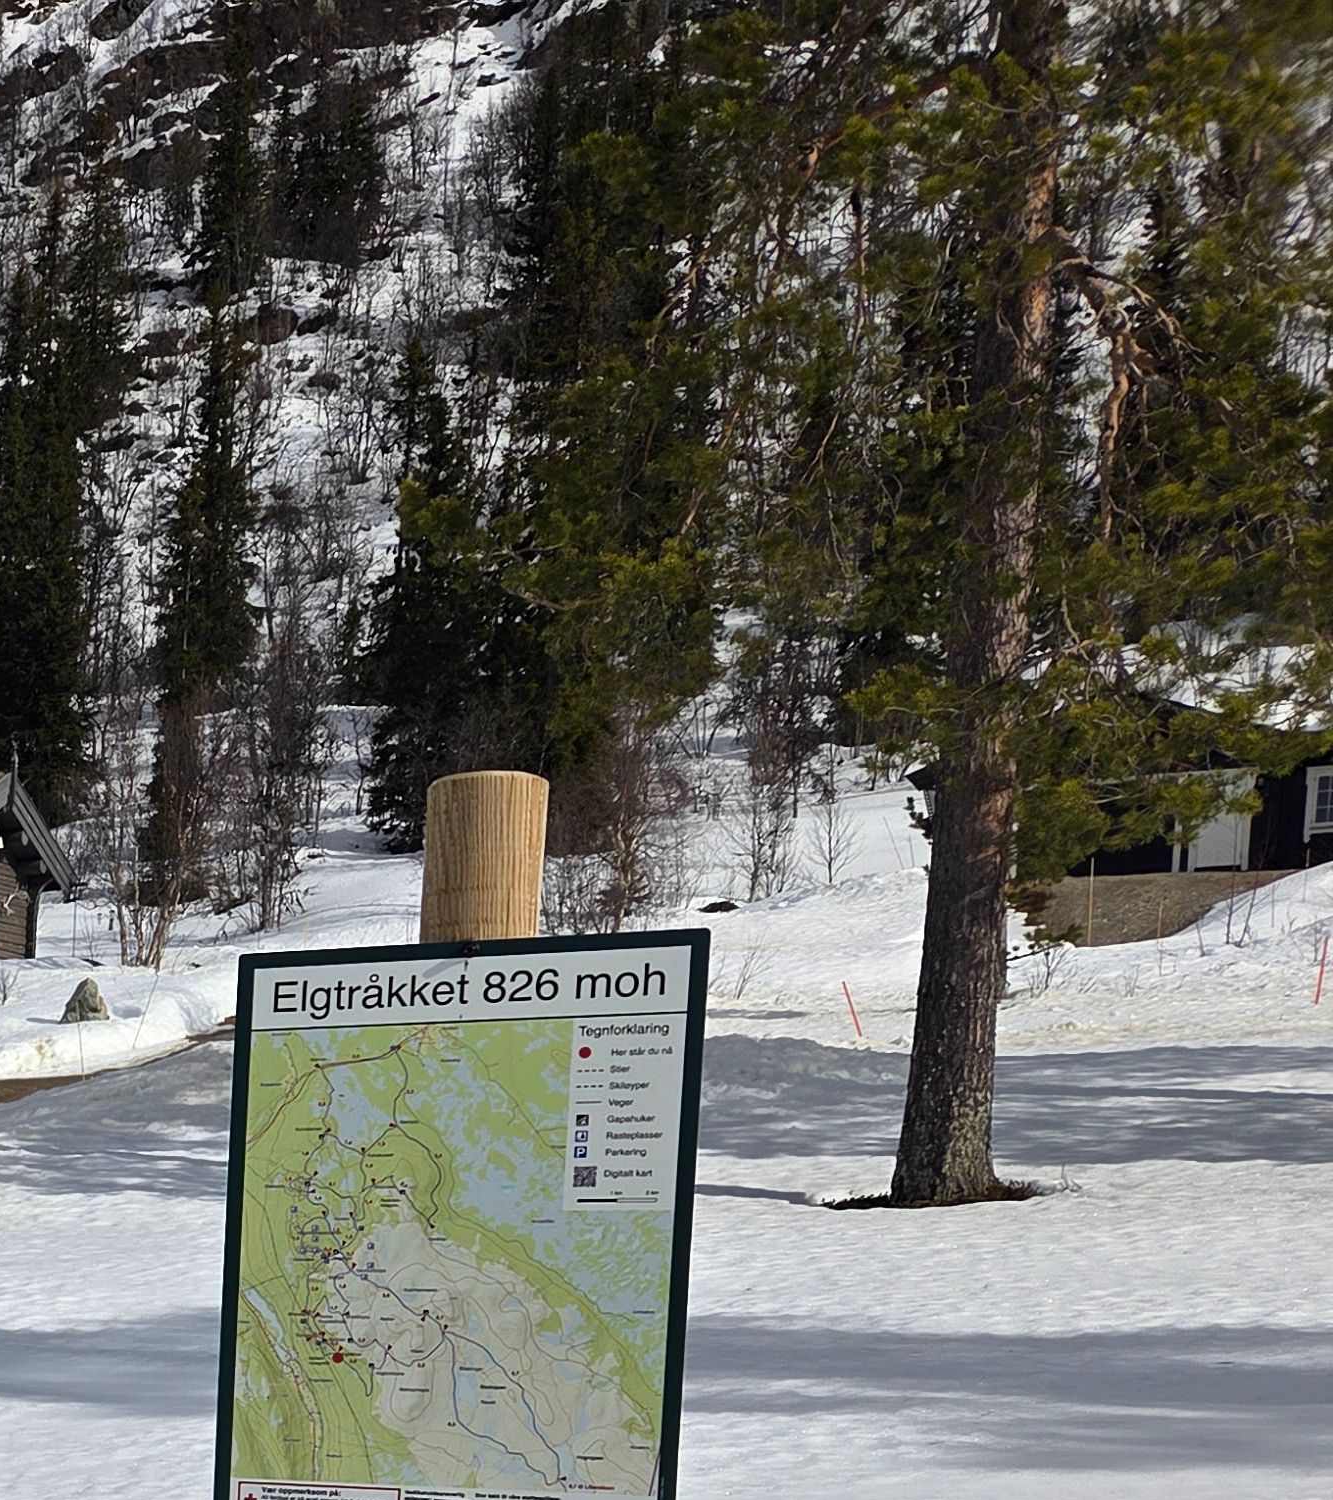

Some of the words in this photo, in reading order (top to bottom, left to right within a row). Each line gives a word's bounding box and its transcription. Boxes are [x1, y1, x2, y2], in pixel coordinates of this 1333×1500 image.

[272, 974, 470, 1019] Elgtråkket
[483, 969, 560, 1003] 826
[575, 962, 667, 999] moh
[578, 1022, 669, 1038] Tegnforklaring
[611, 1048, 626, 1057] Her
[648, 1047, 659, 1055] du
[661, 1046, 672, 1054] nå
